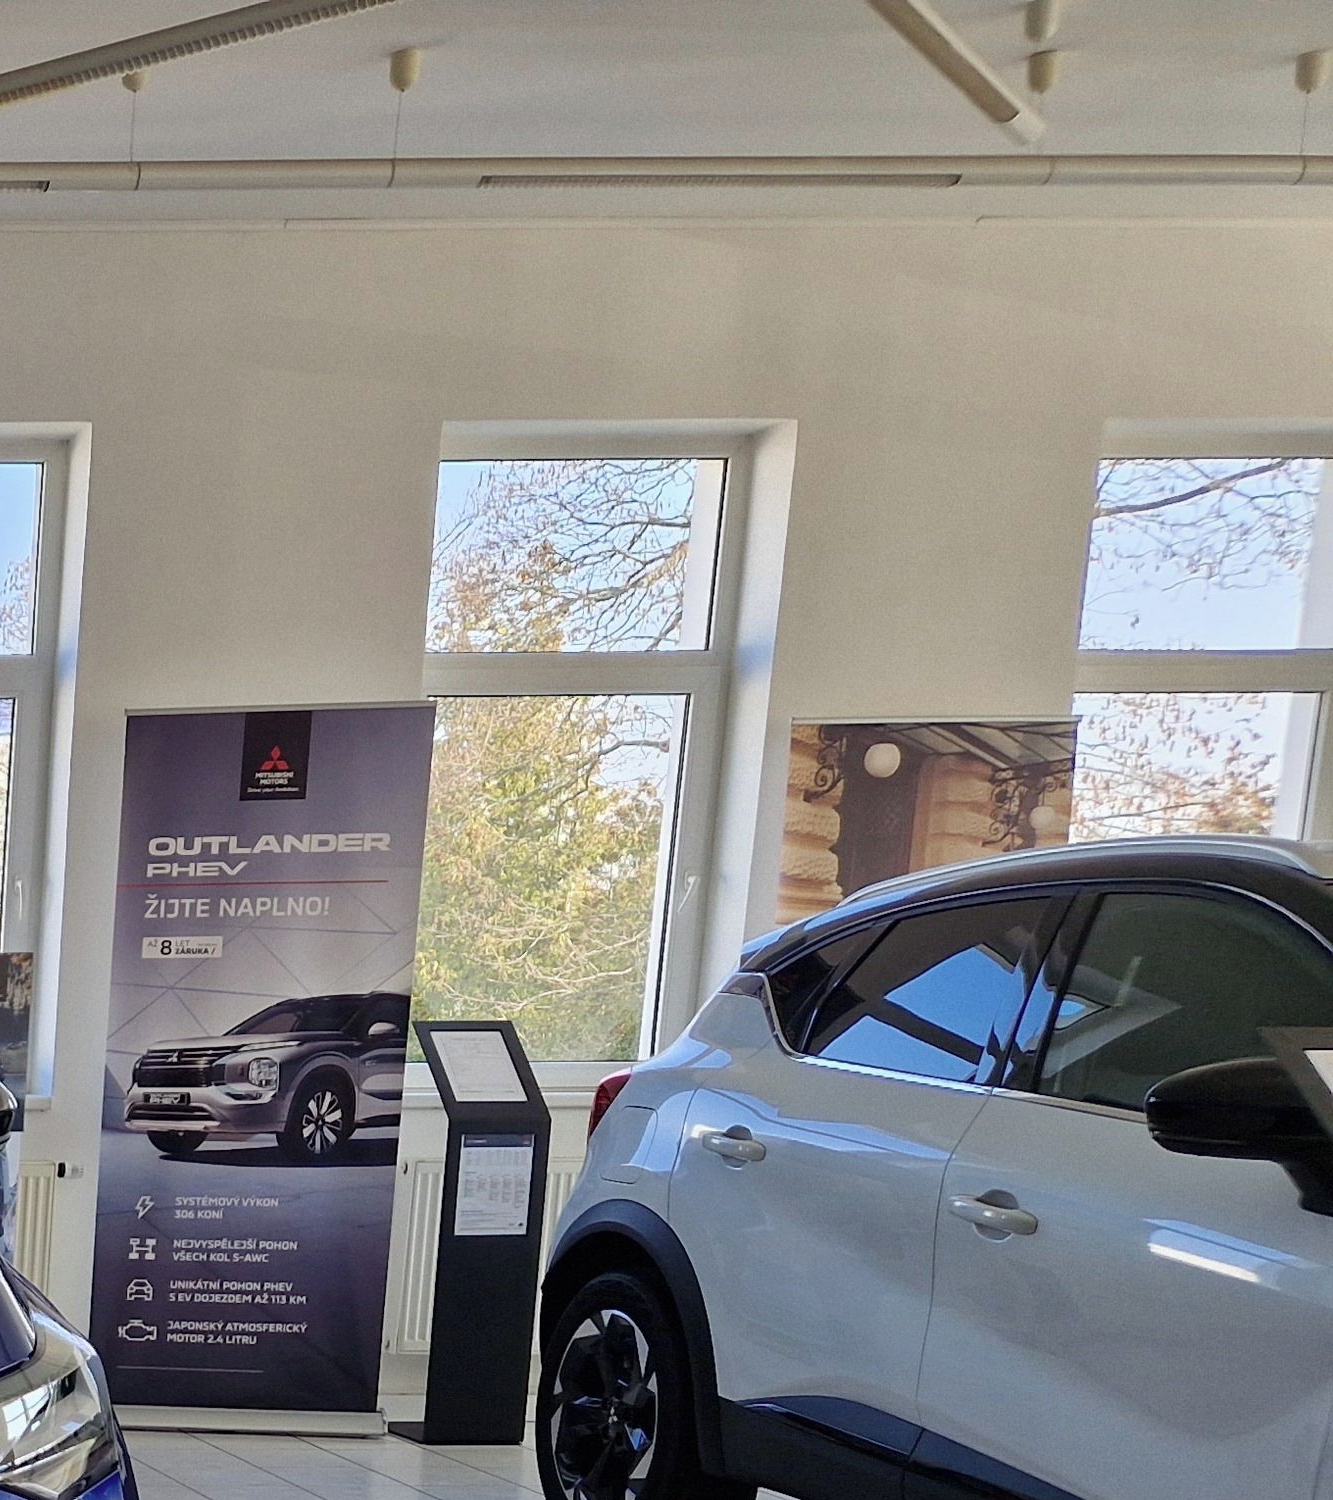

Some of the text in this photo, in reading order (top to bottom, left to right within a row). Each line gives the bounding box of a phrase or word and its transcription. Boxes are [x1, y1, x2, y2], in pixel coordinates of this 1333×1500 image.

[148, 833, 391, 856] OUTLANDER
[146, 861, 248, 877] PHEV
[144, 893, 330, 919] ŽIJTE NAPLNO!
[160, 939, 173, 956] 8
[175, 946, 209, 955] ZÁRUKA
[174, 1195, 279, 1207] SYSTÉMOVÝ VÝKON
[174, 1208, 224, 1219] 306 KONÍ
[173, 1238, 298, 1250] NEJVYSPĚLEJŠÍ POHON
[172, 1250, 270, 1263] VŠECH KOL S-AWC
[170, 1278, 294, 1292] UNIKÁTNÍ POHON PHEV
[169, 1293, 307, 1305] S EV DOJEZDEM AŽ 113 KM
[167, 1320, 308, 1333] JAPONSKÝ ATMOSFERICKÝ
[167, 1334, 257, 1345] MOTOR 2.4 LITRU
